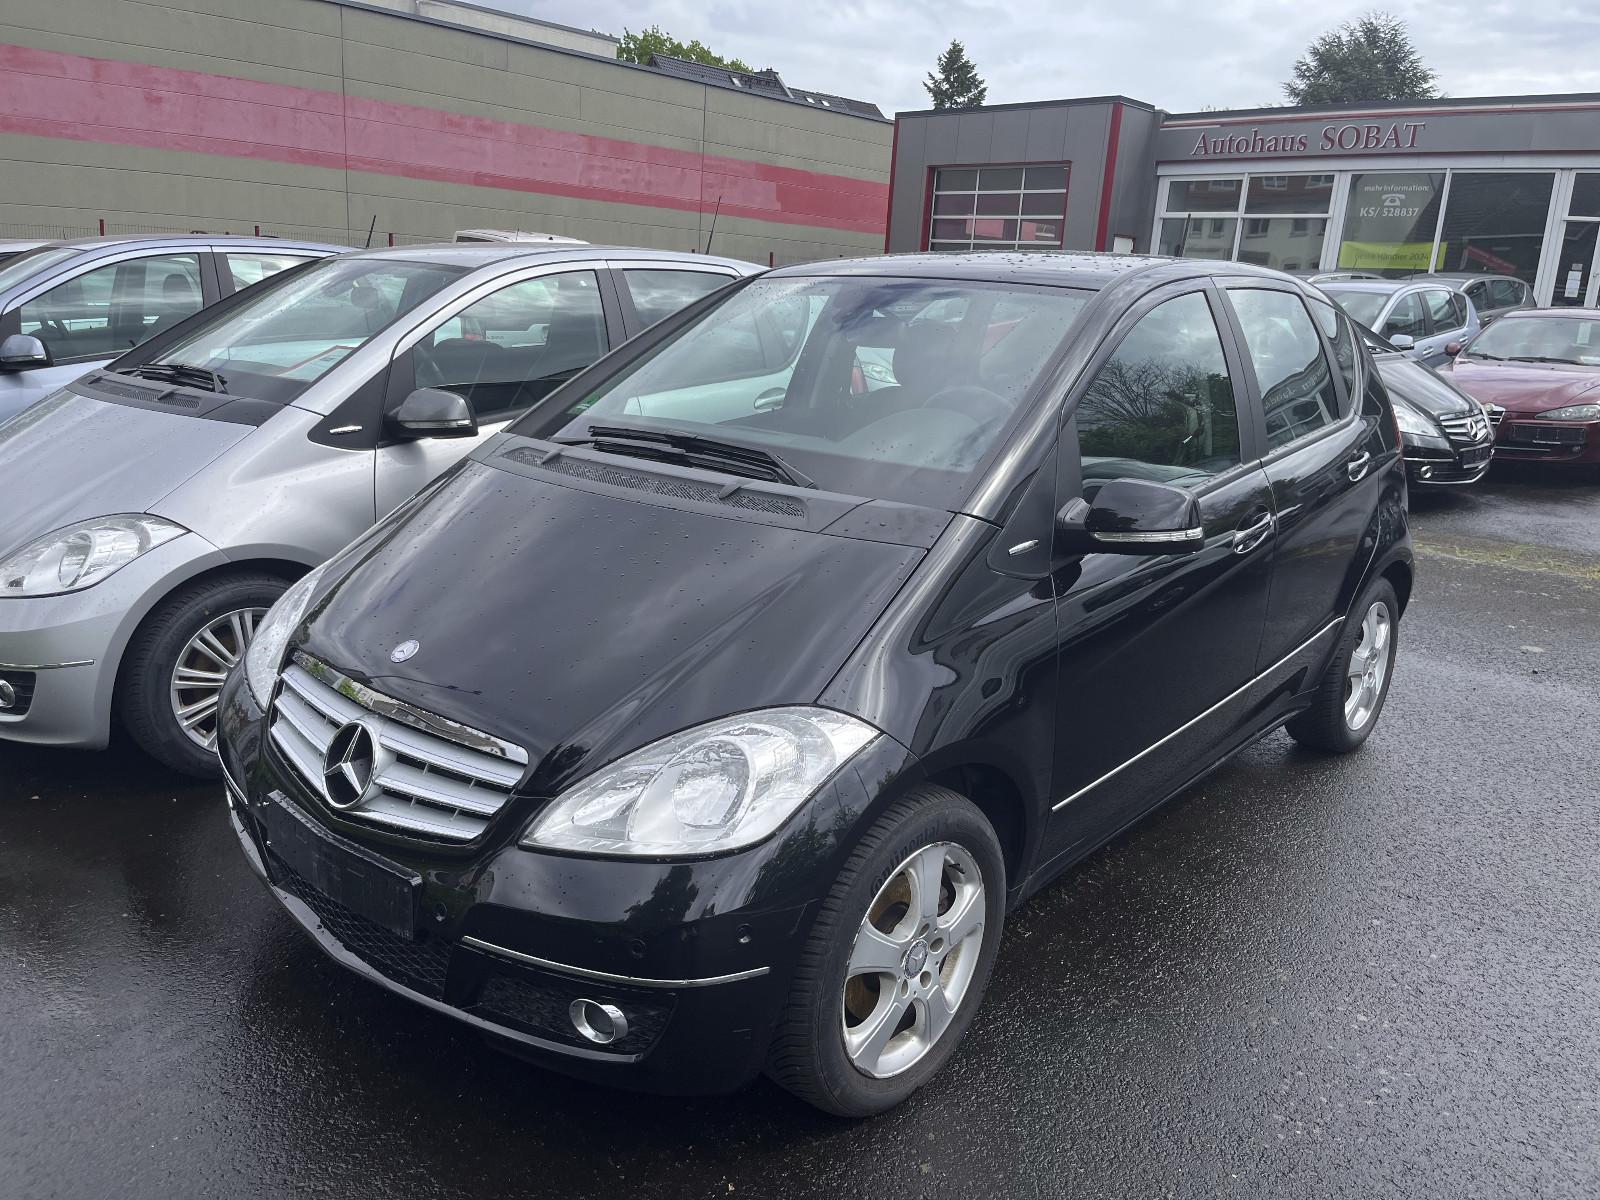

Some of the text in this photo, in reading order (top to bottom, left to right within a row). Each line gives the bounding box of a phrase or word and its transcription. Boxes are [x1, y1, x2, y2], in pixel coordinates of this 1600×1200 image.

[1191, 122, 1426, 156] Autohaus SOBAT
[1360, 207, 1419, 218] KS/ 528837
